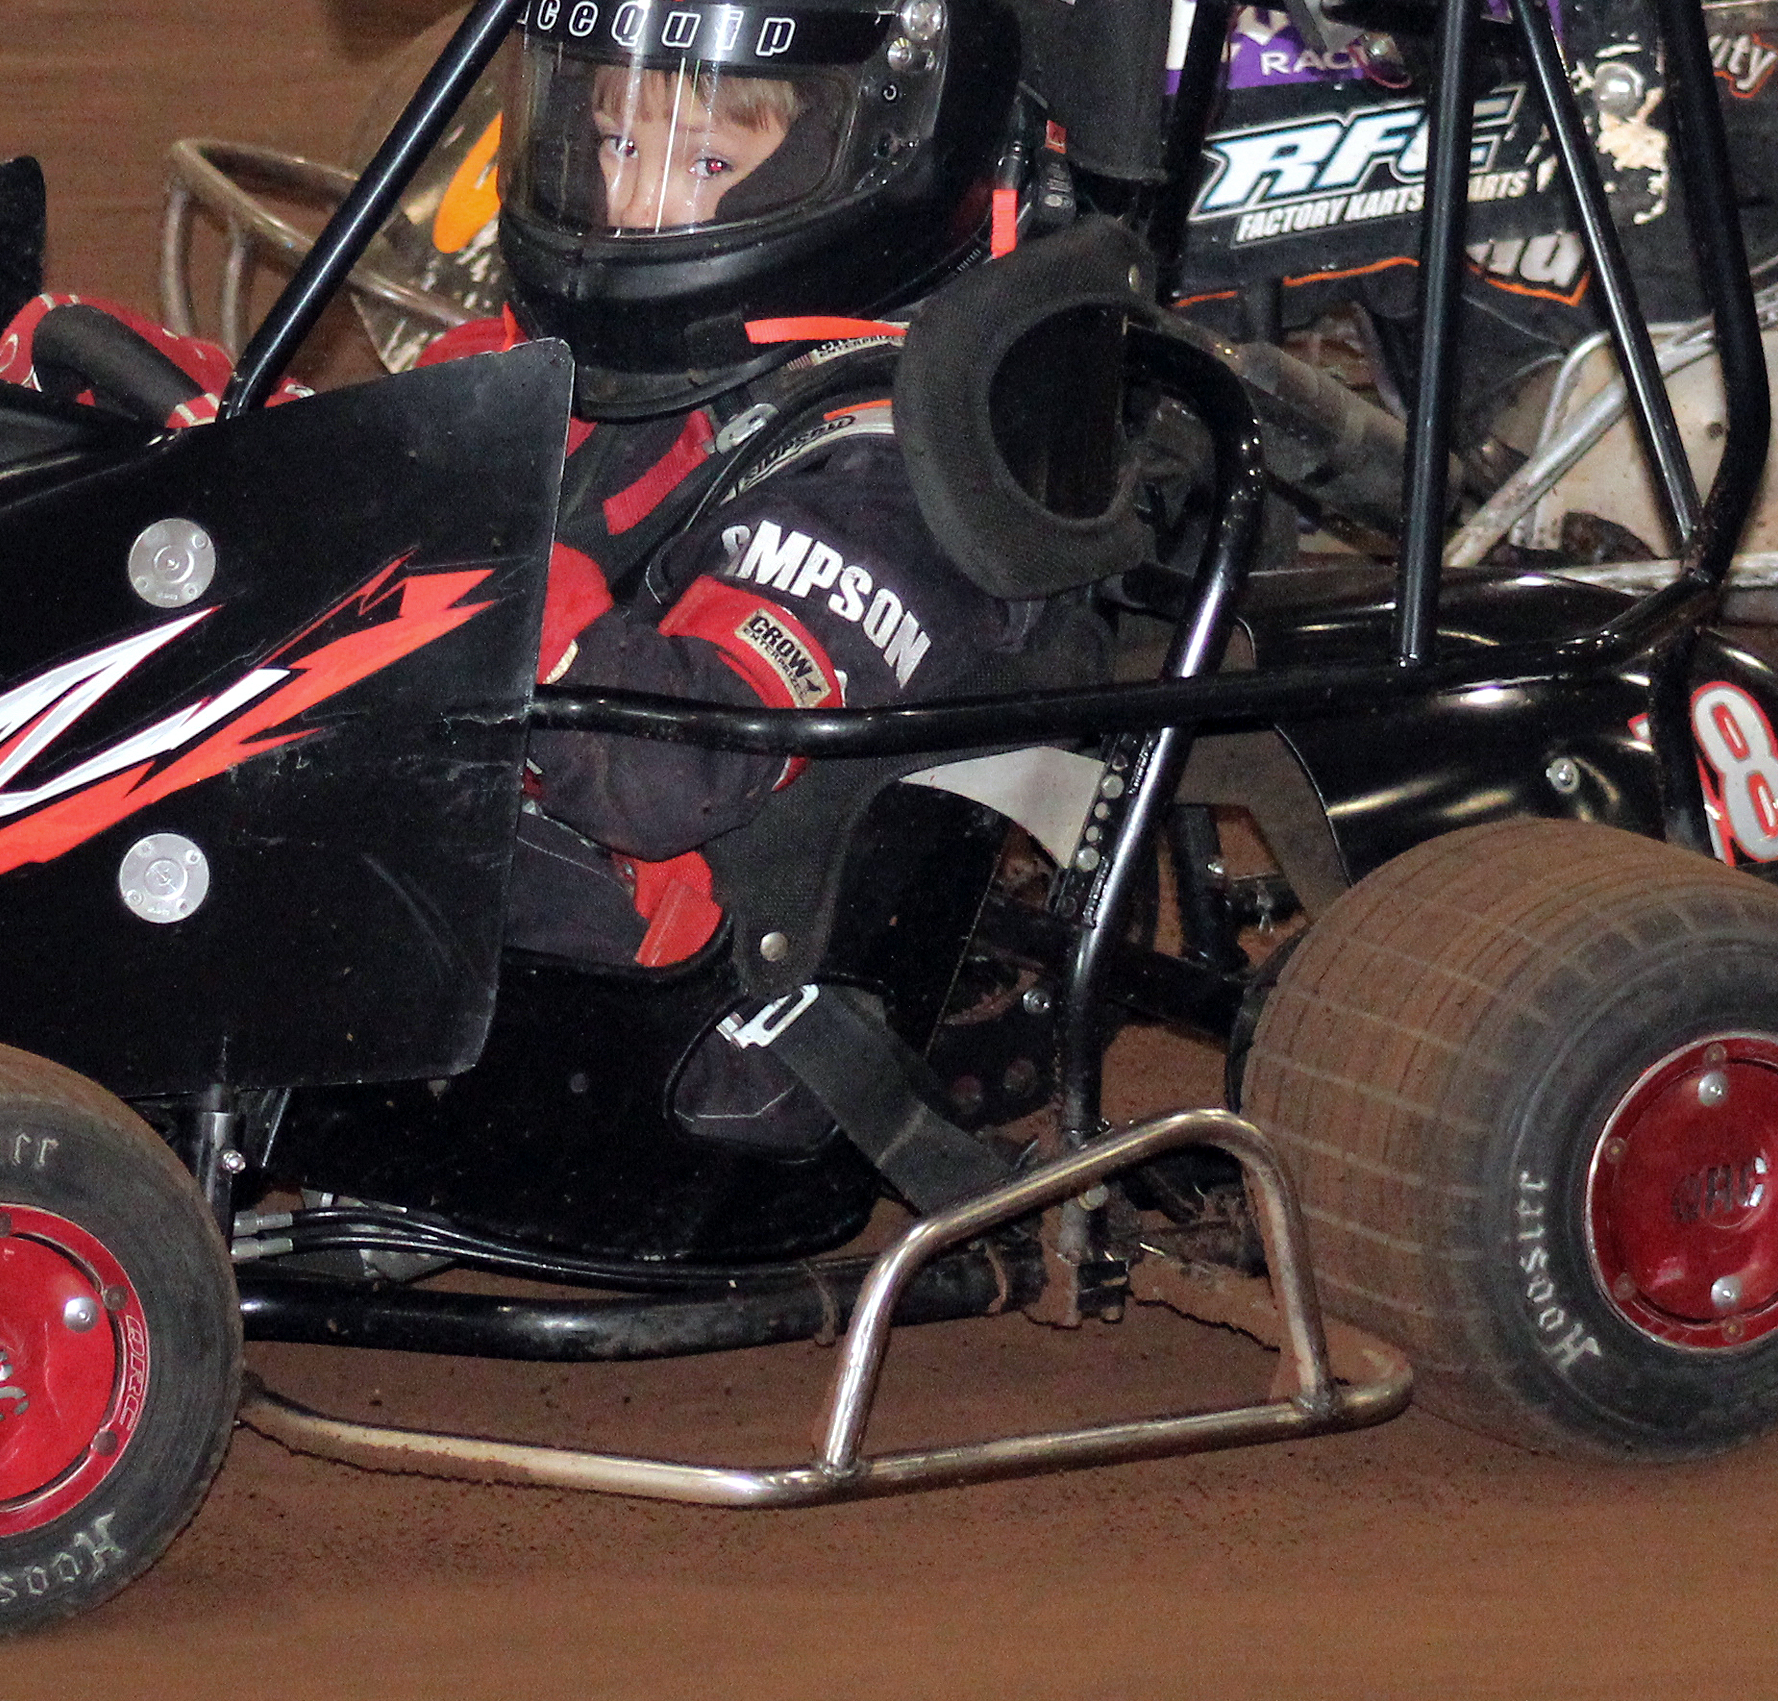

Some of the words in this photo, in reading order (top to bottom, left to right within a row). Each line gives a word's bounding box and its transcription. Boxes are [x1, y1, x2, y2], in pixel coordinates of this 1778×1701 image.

[1235, 199, 1347, 245] FACTORY
[1344, 186, 1424, 224] KARTS
[721, 519, 933, 689] SMPSON
[749, 615, 814, 679] CROW
[1516, 1171, 1603, 1372] Hoosier
